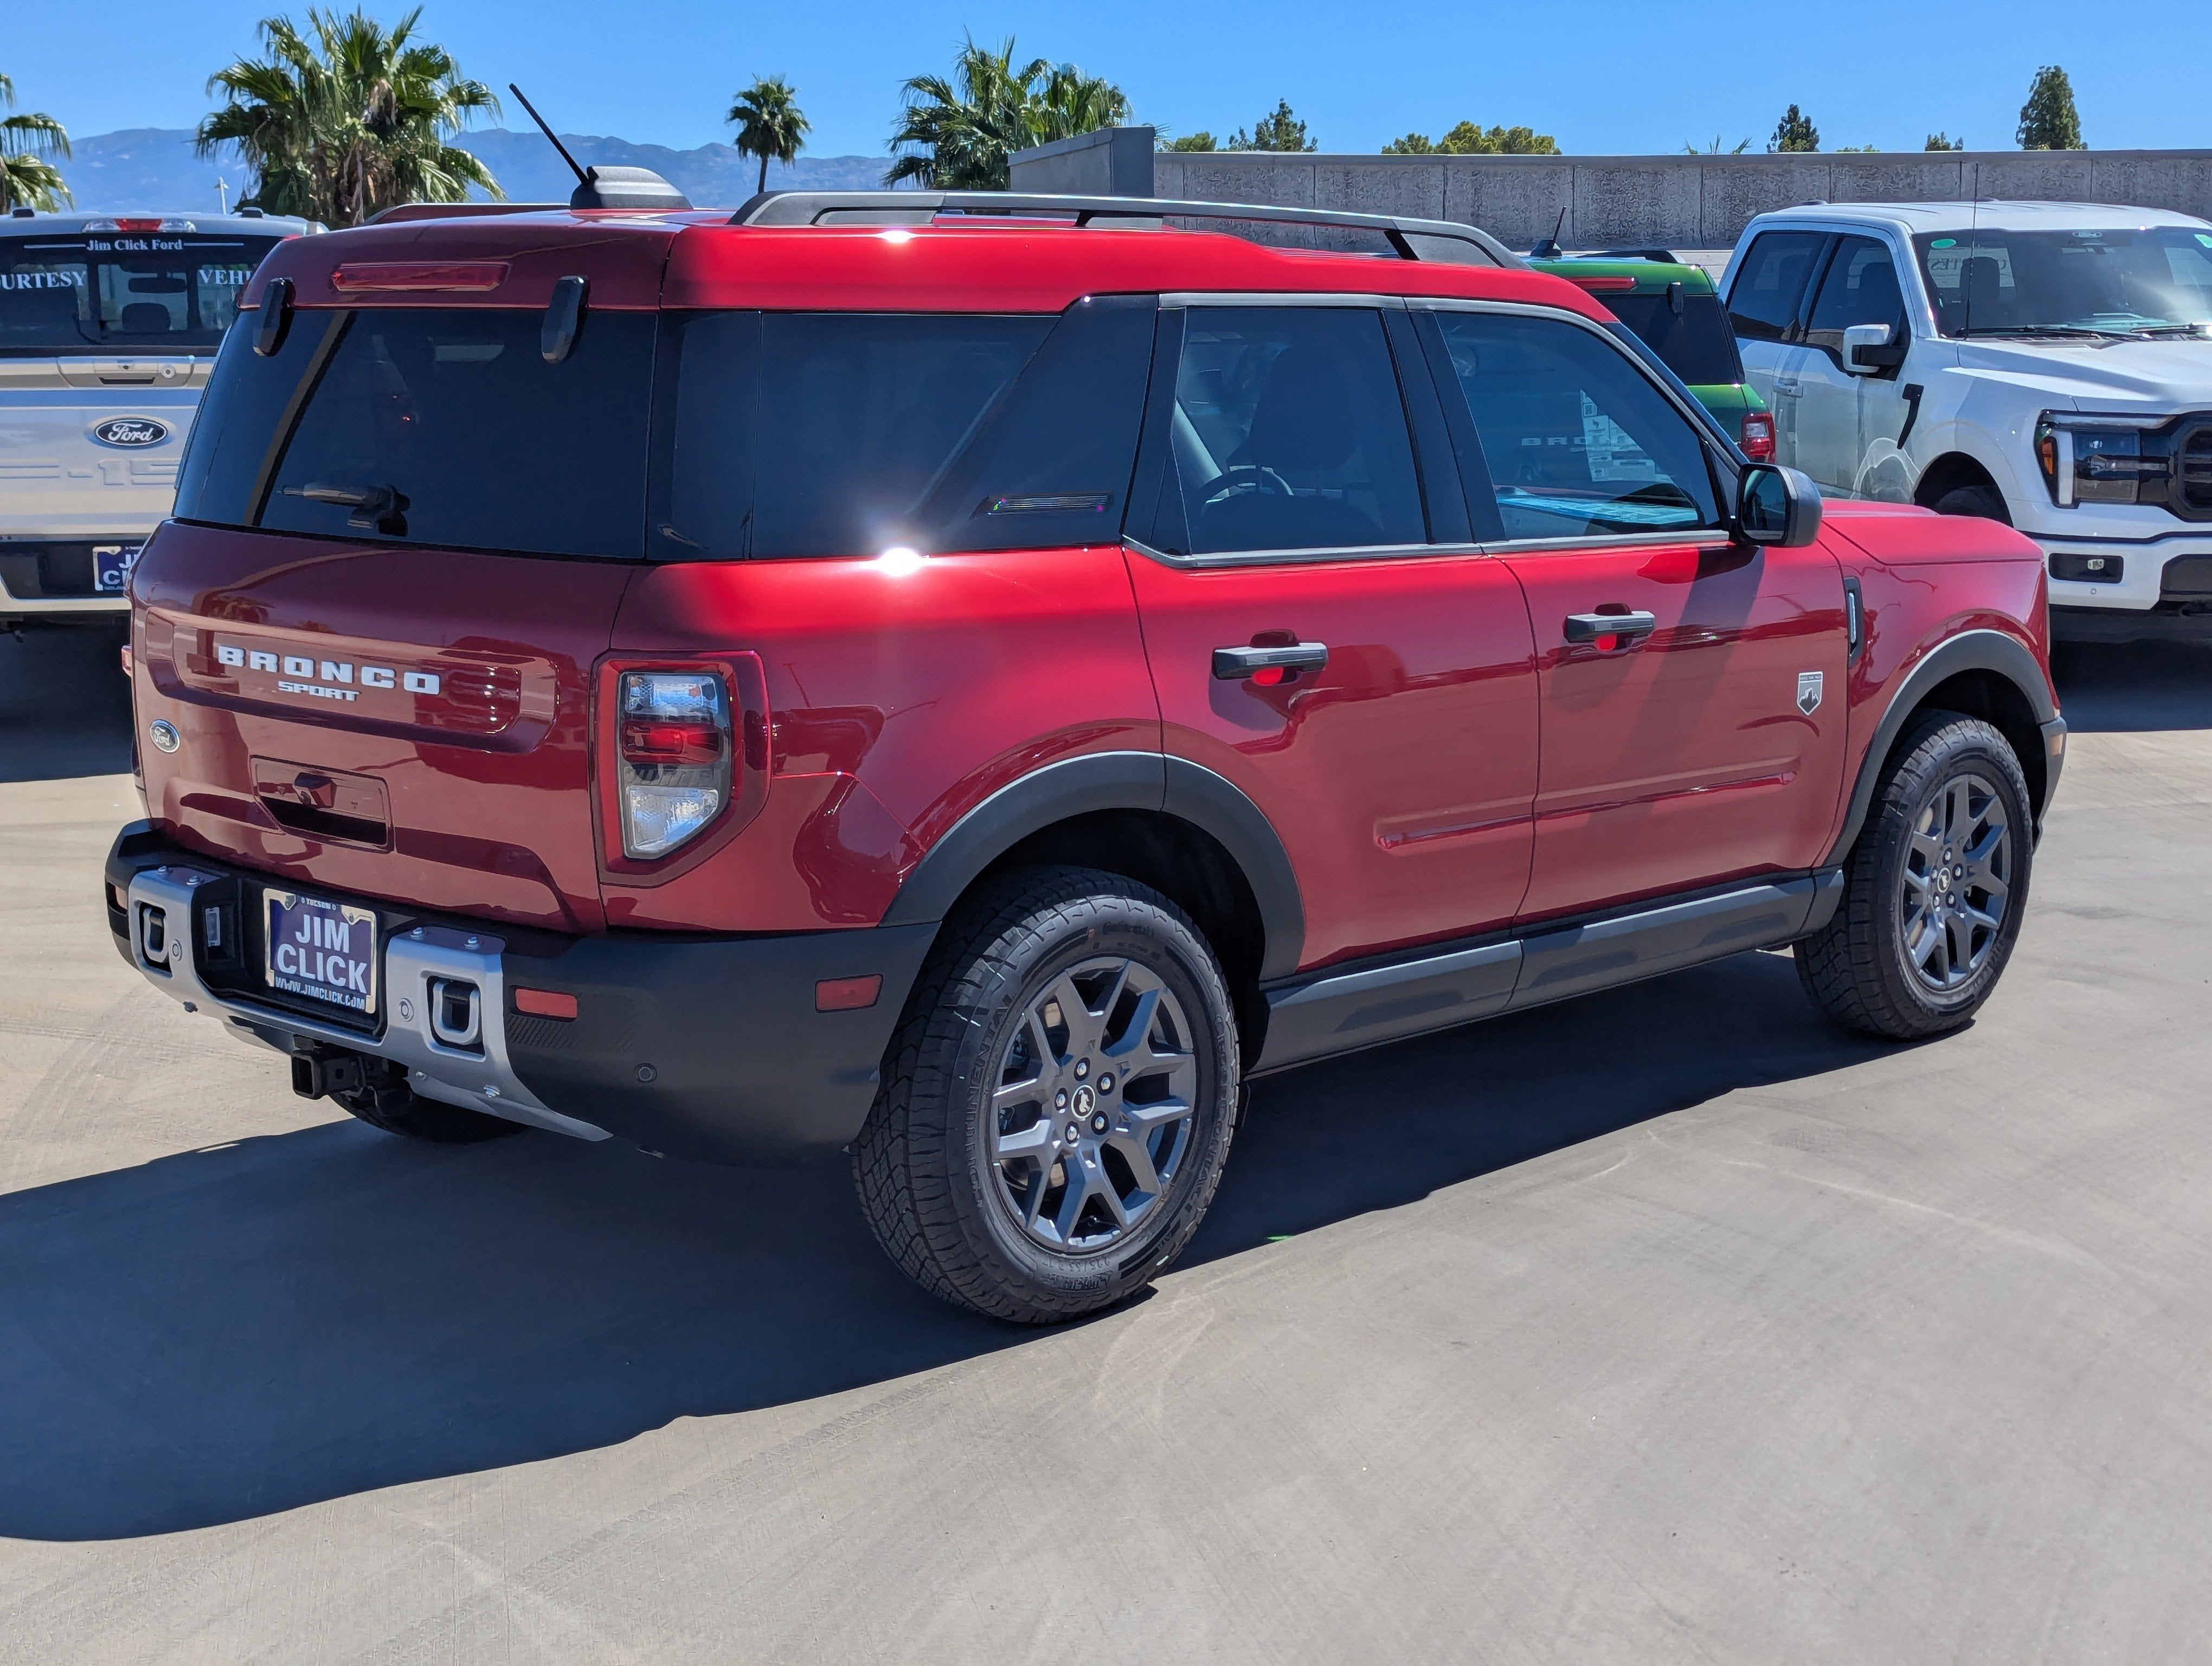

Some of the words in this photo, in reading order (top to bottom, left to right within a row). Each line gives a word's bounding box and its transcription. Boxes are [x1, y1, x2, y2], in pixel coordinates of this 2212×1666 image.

[86, 239, 111, 251] Jim
[114, 239, 148, 251] Click
[152, 239, 183, 250] Ford
[0, 271, 87, 290] URTESY
[108, 422, 154, 442] Ford
[218, 645, 440, 695] BRONCO
[278, 681, 362, 701] SPORT
[295, 914, 350, 953] JIM
[277, 944, 368, 994] CLICK
